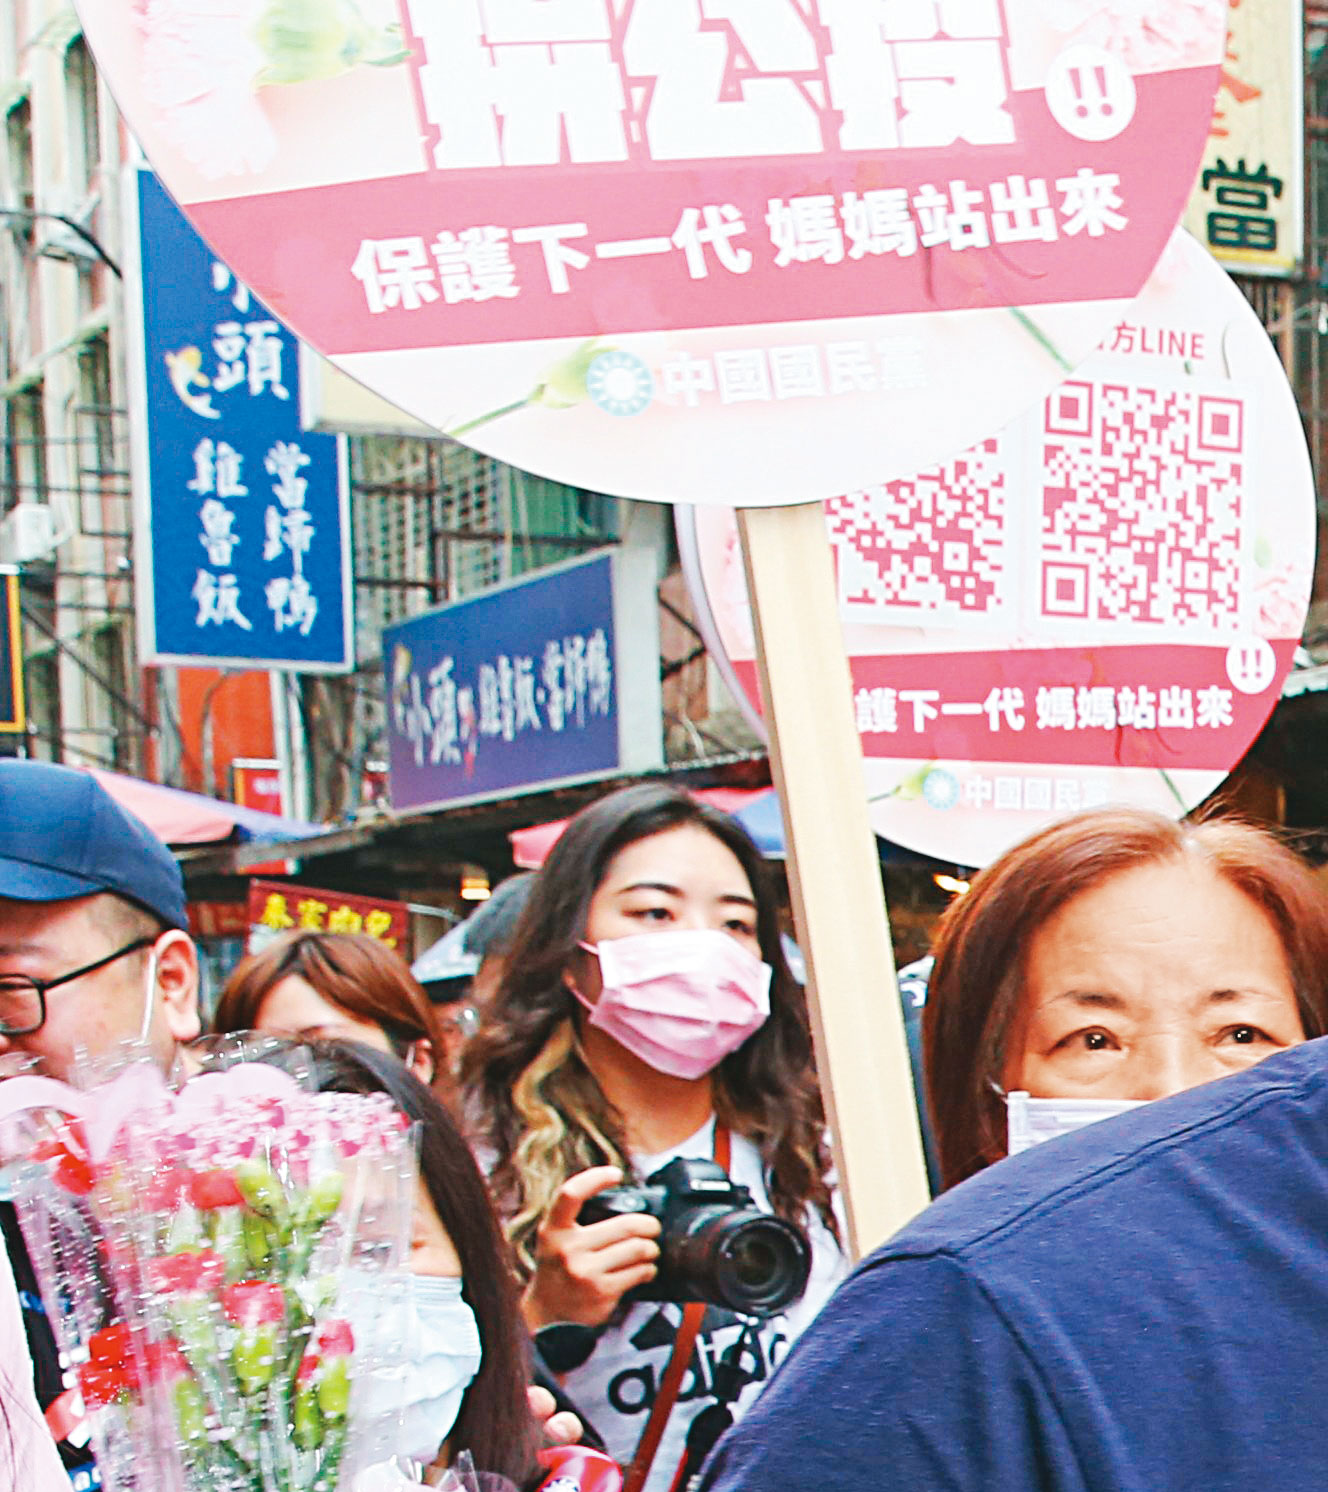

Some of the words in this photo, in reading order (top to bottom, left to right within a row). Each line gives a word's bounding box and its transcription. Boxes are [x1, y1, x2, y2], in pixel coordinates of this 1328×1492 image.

[350, 203, 753, 314] 保護下一代
[766, 167, 1129, 269] 媽媽站出來
[1097, 320, 1205, 360] 方LINE
[1035, 685, 1234, 731] 媽媽站出來
